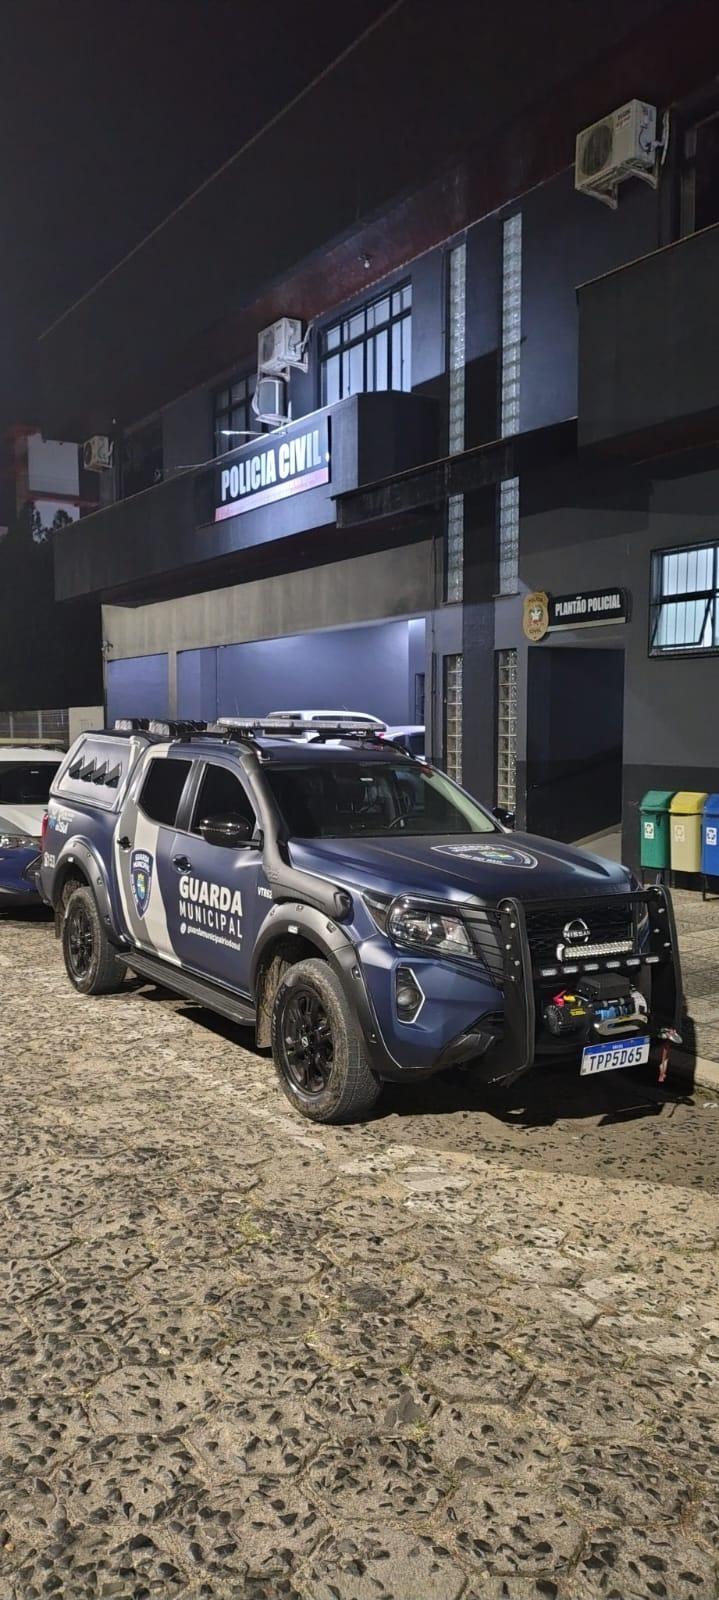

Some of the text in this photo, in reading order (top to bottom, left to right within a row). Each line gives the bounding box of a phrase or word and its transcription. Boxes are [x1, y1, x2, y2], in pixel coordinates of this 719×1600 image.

[221, 429, 321, 502] POLICIA CIVIL
[555, 594, 621, 617] PLANTÃO POLICIAL
[179, 875, 243, 917] GUARDA
[179, 899, 243, 939] MUNICIPAL
[563, 930, 591, 938] NISSAN
[590, 1048, 642, 1071] TPP5D65
